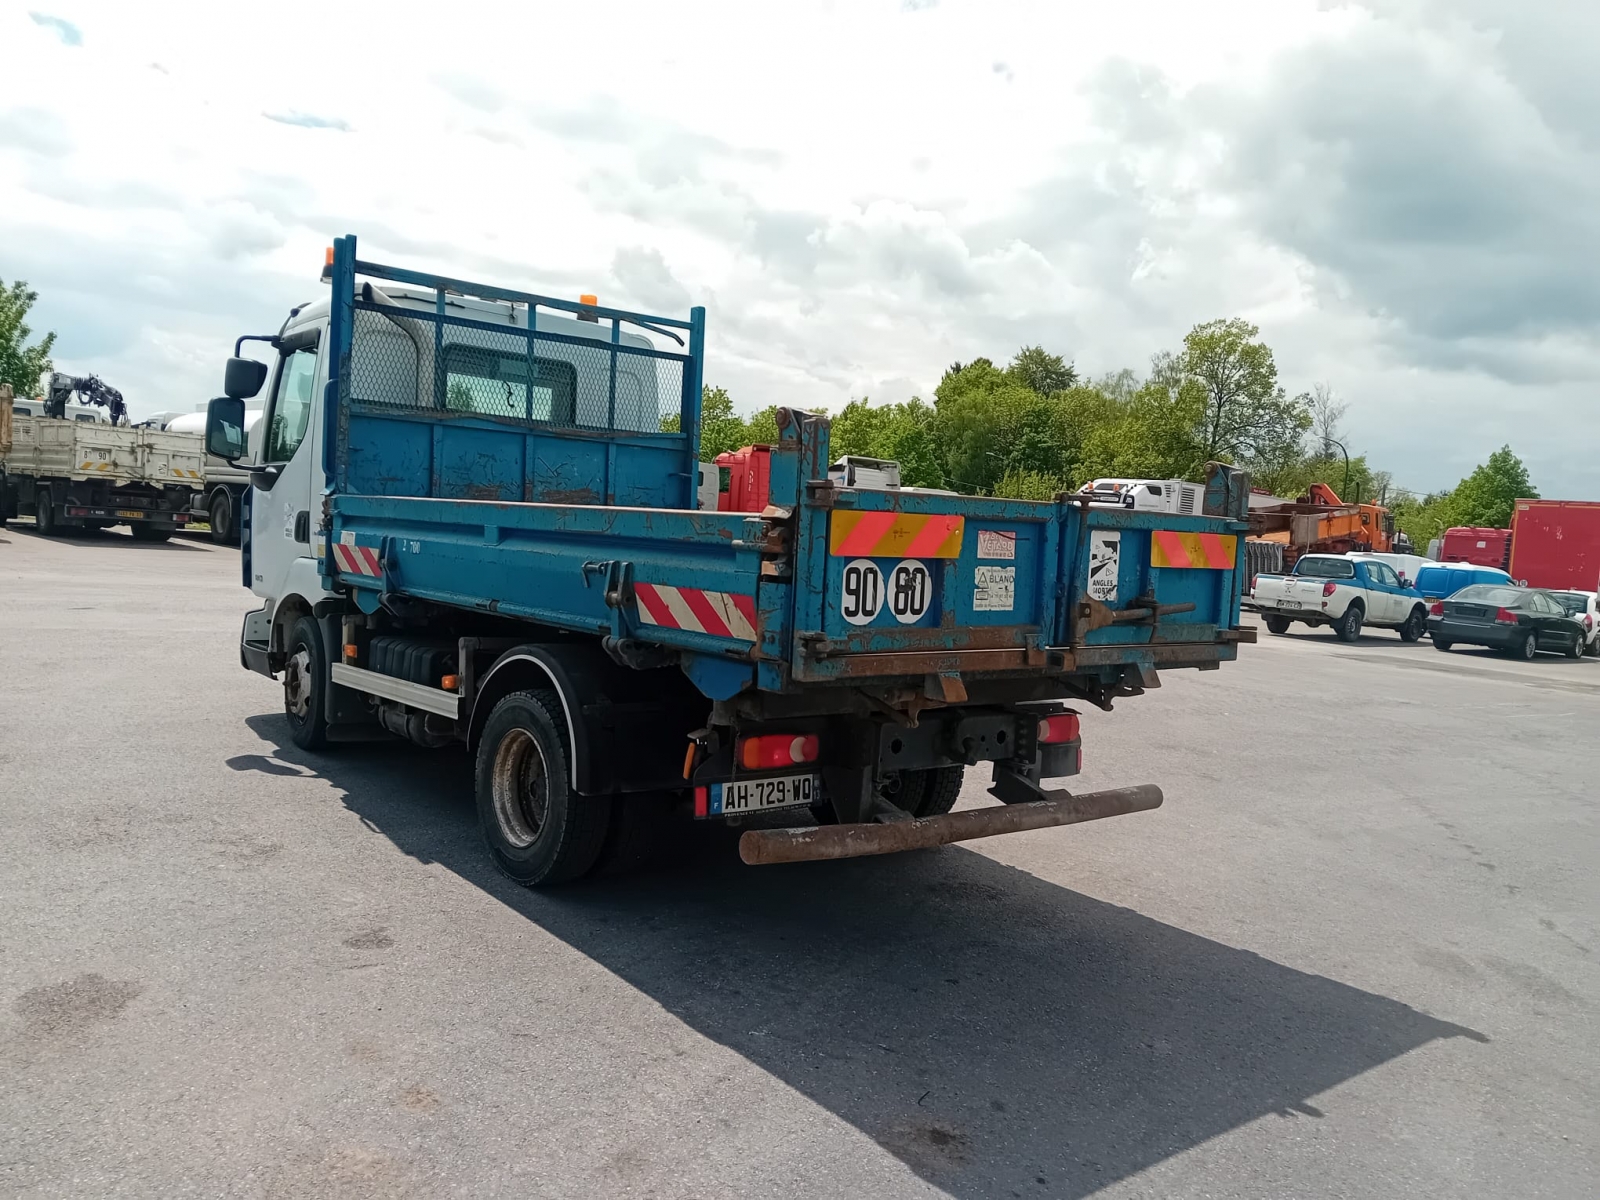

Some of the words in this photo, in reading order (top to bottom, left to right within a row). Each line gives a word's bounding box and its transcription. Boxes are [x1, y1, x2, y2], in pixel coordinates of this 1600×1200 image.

[98, 452, 107, 460] 90
[844, 567, 878, 617] 90
[894, 567, 925, 615] 80
